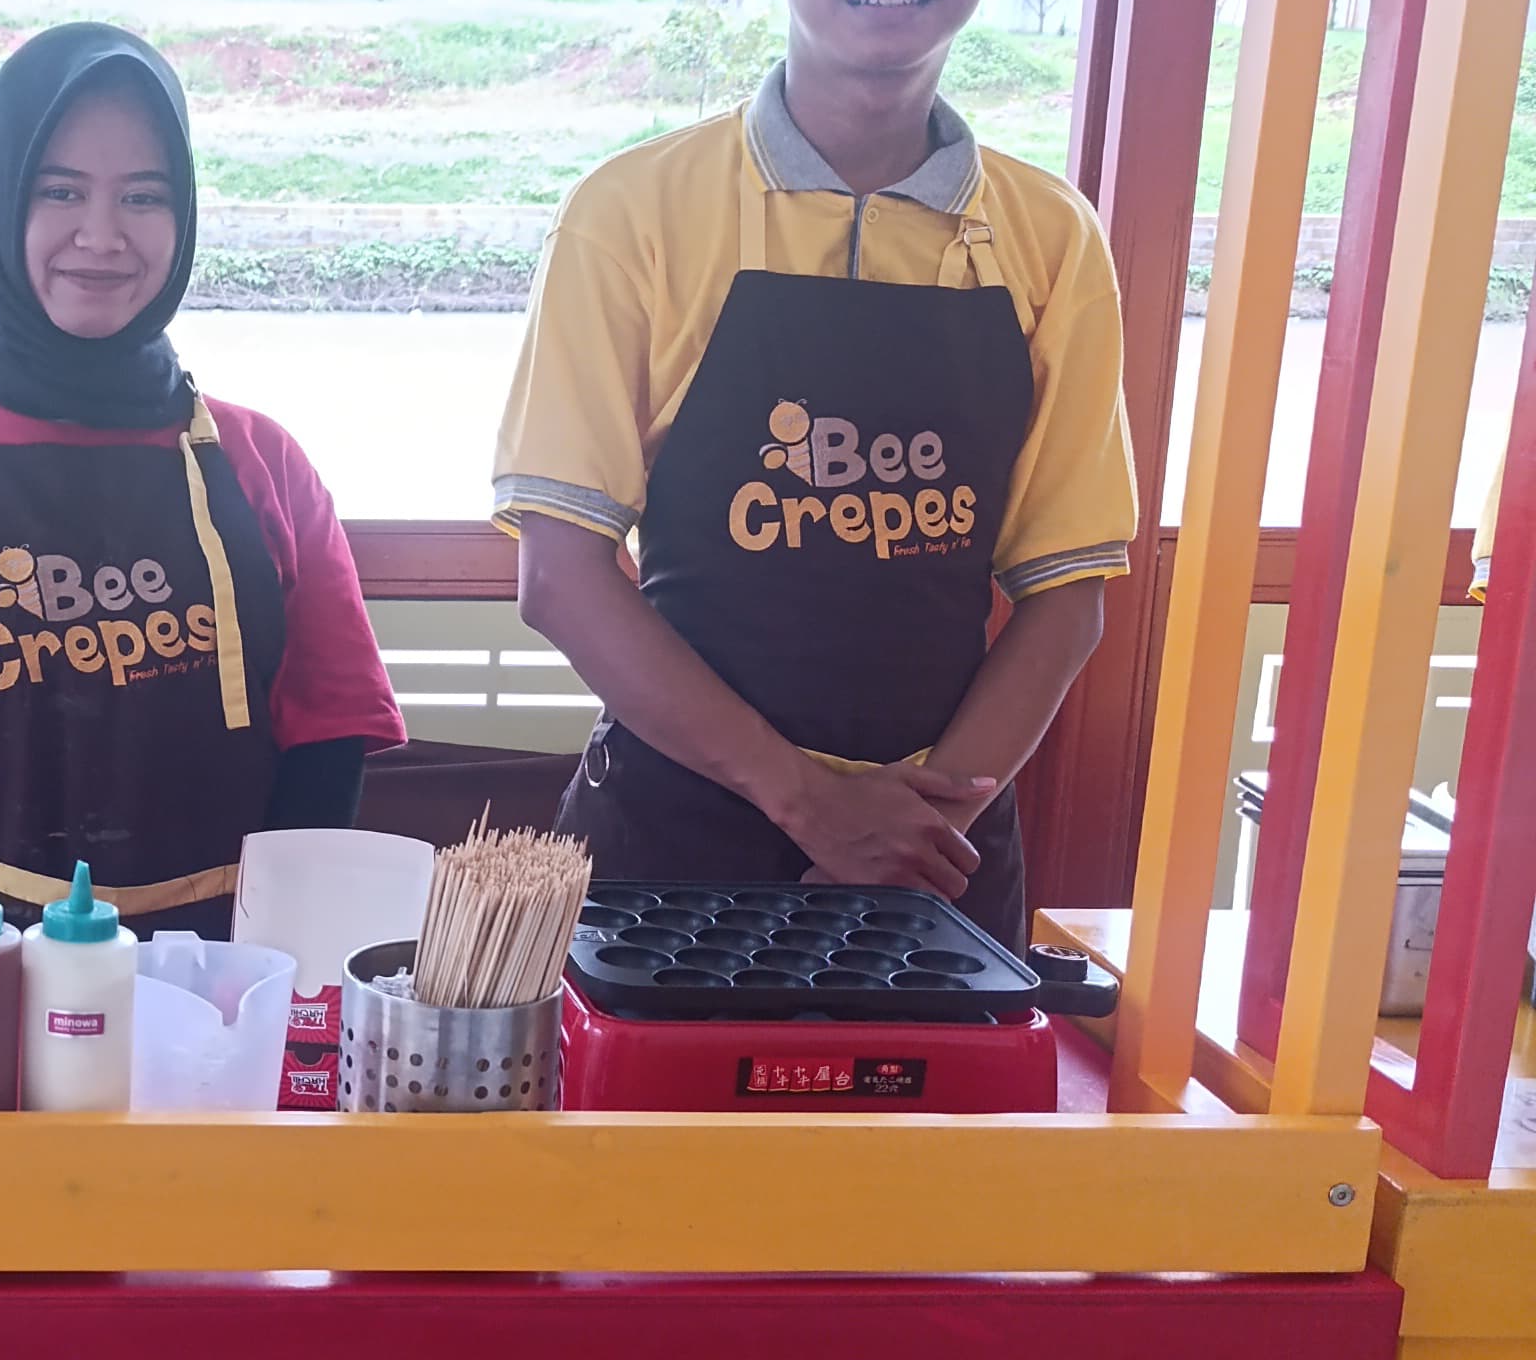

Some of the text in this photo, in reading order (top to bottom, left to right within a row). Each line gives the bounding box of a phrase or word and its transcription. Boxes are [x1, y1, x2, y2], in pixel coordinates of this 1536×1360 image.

[811, 417, 946, 487] Bee
[729, 481, 977, 559] Crepes
[36, 554, 173, 622] Bee
[54, 1016, 98, 1028] minowa
